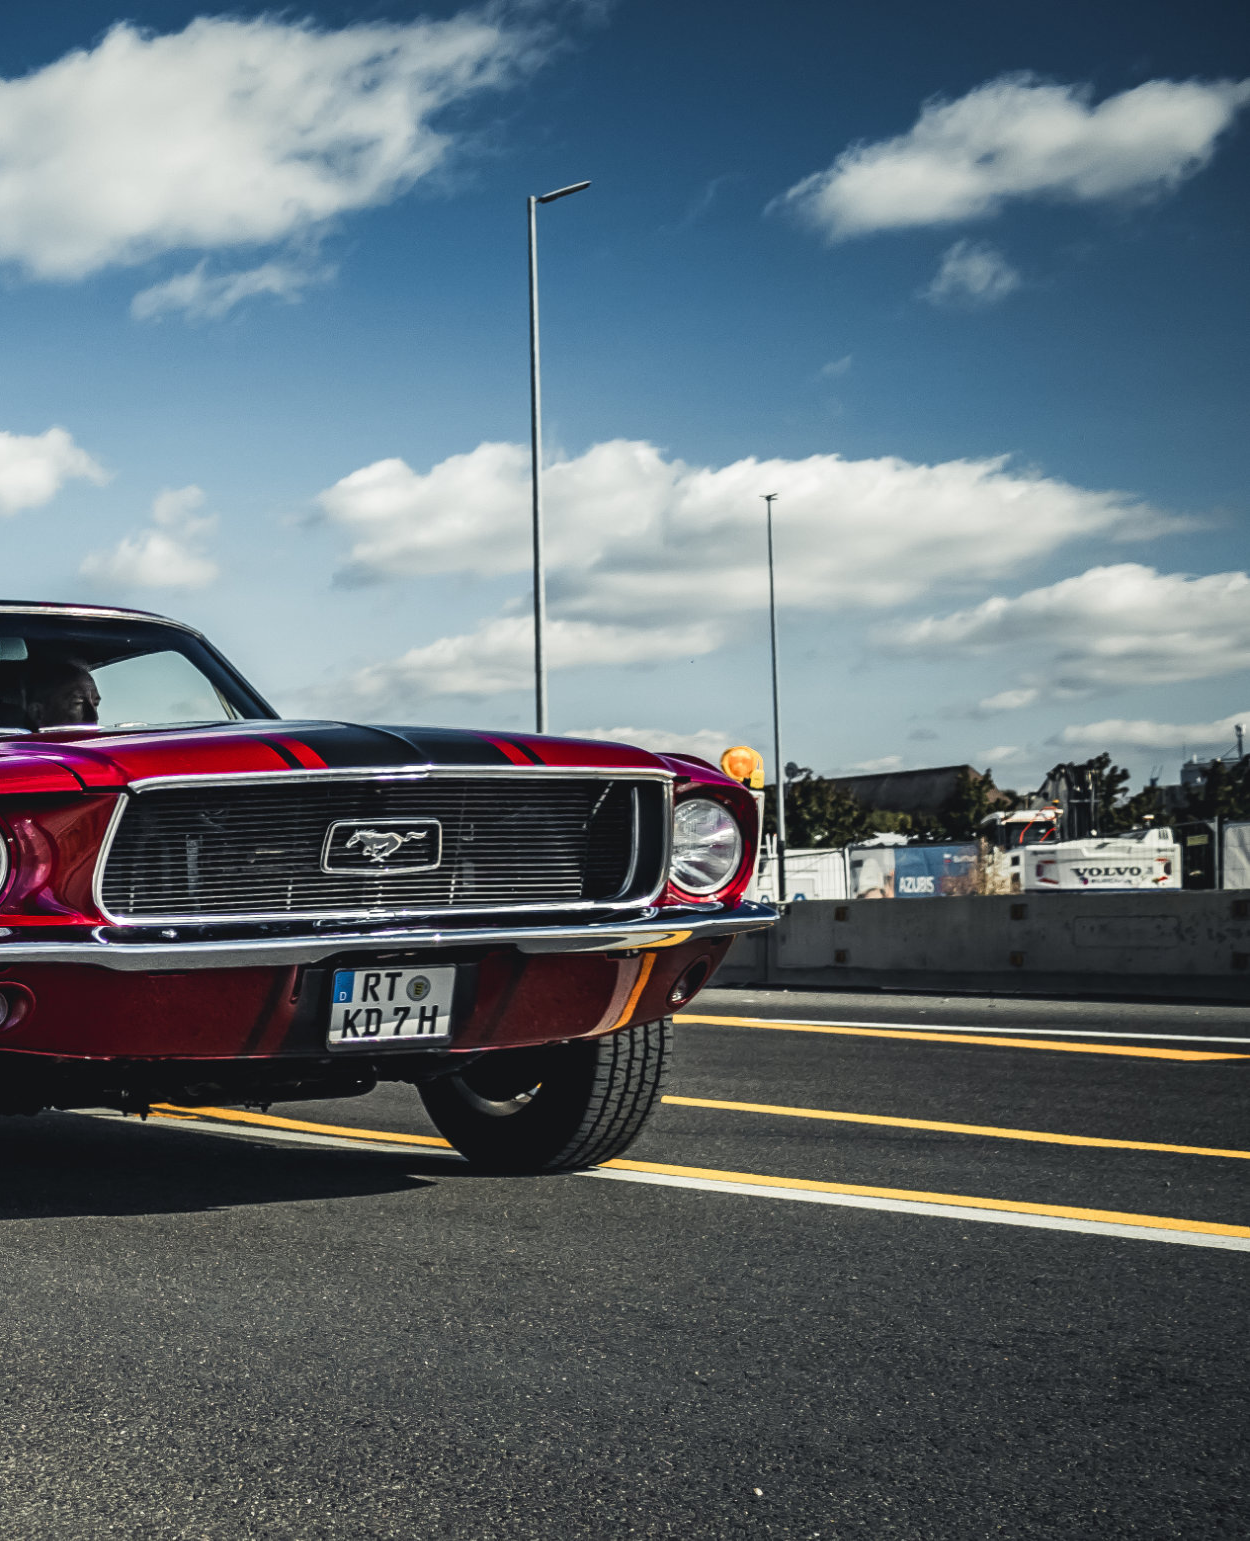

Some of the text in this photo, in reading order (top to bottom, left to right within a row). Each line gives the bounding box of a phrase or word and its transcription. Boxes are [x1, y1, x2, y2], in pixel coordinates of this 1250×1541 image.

[1071, 866, 1141, 877] VOLVO
[339, 991, 347, 1001] D
[361, 972, 403, 1002] RT
[342, 1007, 383, 1038] KD
